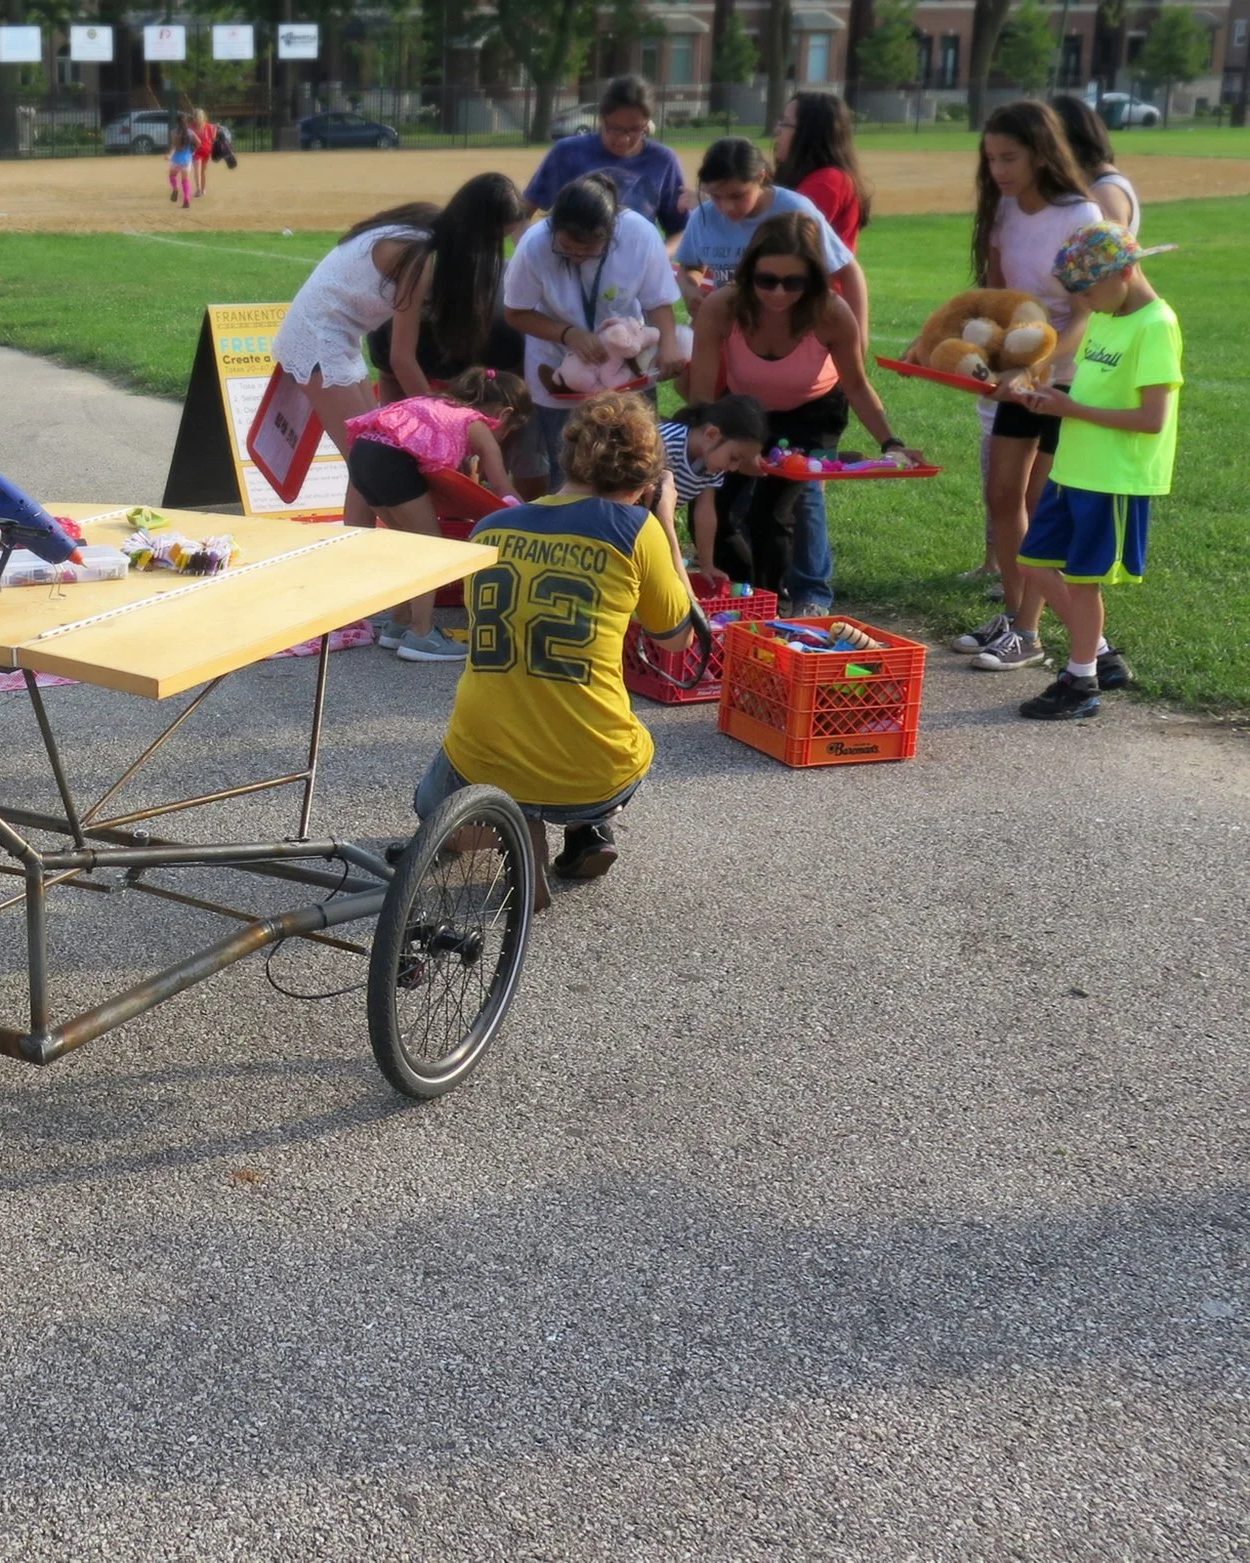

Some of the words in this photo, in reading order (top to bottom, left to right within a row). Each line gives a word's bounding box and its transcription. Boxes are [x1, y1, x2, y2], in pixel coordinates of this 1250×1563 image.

[222, 354, 261, 364] Create
[263, 355, 271, 363] a
[502, 534, 607, 574] FRANCISCO
[470, 561, 600, 685] 82
